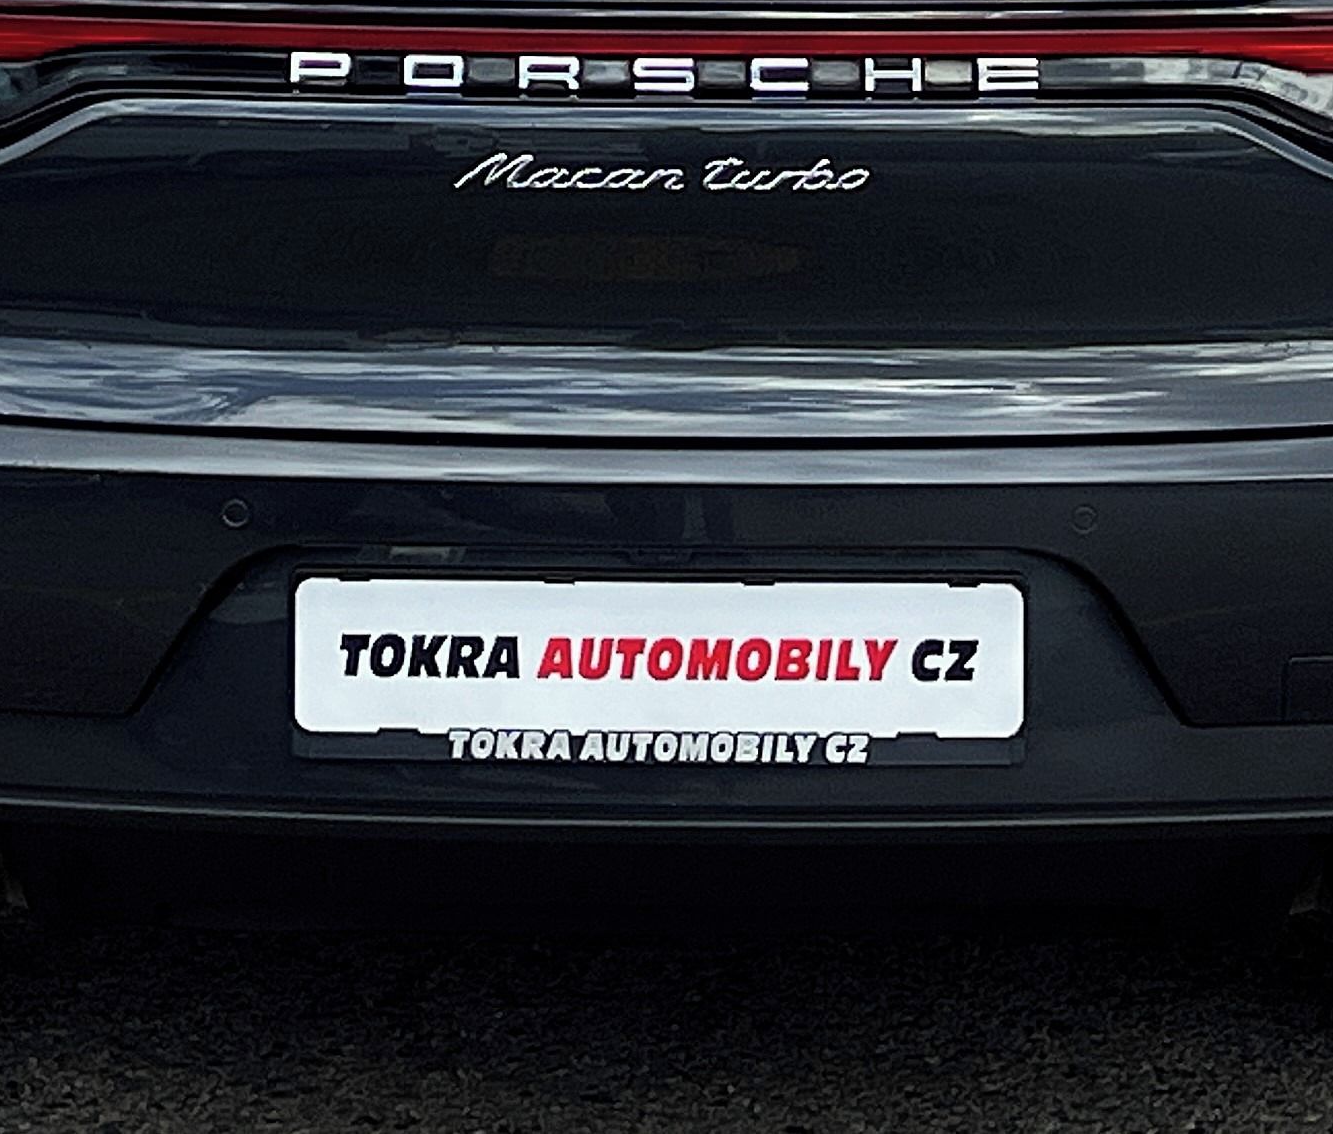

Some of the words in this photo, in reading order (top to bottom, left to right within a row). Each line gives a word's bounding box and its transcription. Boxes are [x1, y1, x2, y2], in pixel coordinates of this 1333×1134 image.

[290, 52, 1039, 92] PORSCHE
[454, 152, 686, 191] Macan
[700, 154, 870, 192] turbo
[340, 634, 520, 680] TOKRA
[537, 636, 898, 682] AUTOMOBILY
[910, 639, 980, 681] CZ
[448, 730, 571, 762] TOKRA
[579, 731, 815, 763] AUTOMOBILY
[825, 733, 869, 763] CZ
